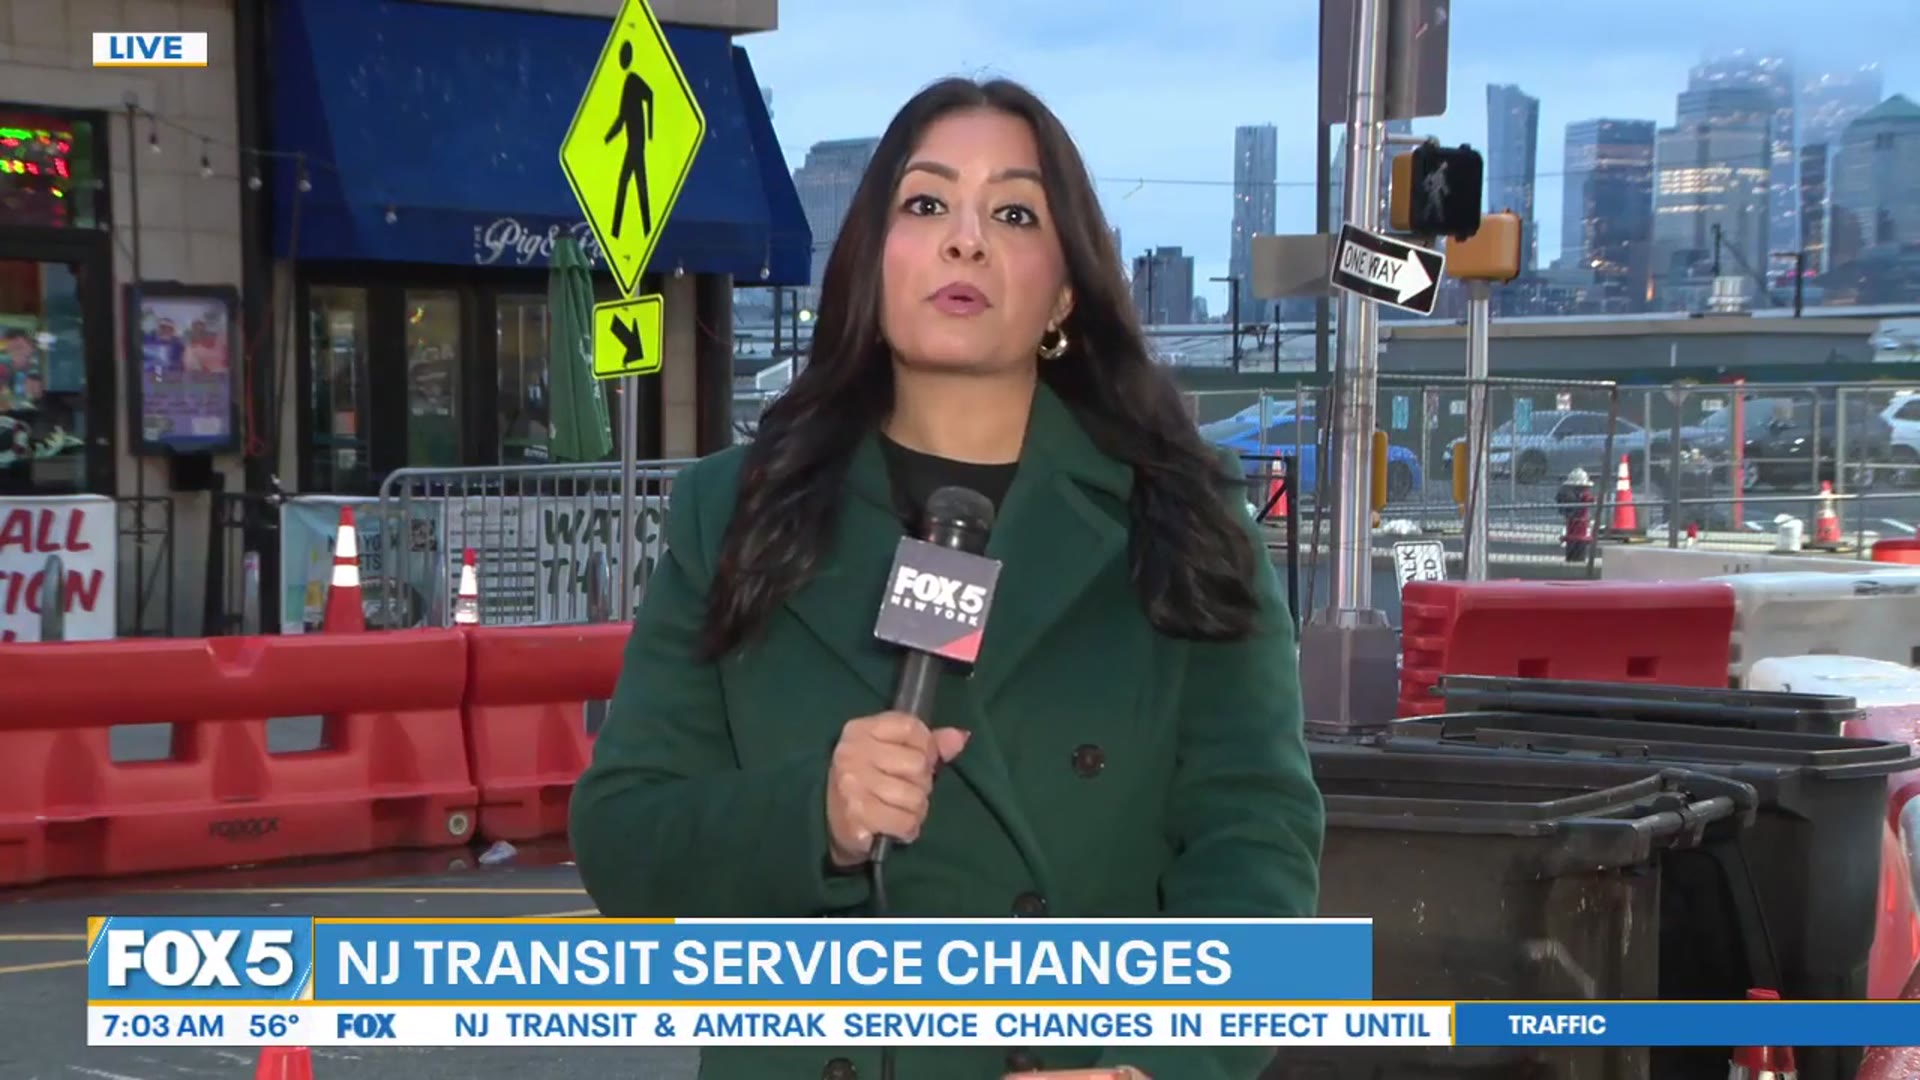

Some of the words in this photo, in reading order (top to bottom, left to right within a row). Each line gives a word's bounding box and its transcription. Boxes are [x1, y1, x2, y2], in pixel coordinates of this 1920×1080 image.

[1344, 245, 1367, 274] ONE
[1368, 254, 1403, 284] WAY
[894, 565, 963, 609] FOX
[958, 584, 987, 614] 5
[890, 594, 927, 612] NEW
[934, 606, 979, 627] YORK
